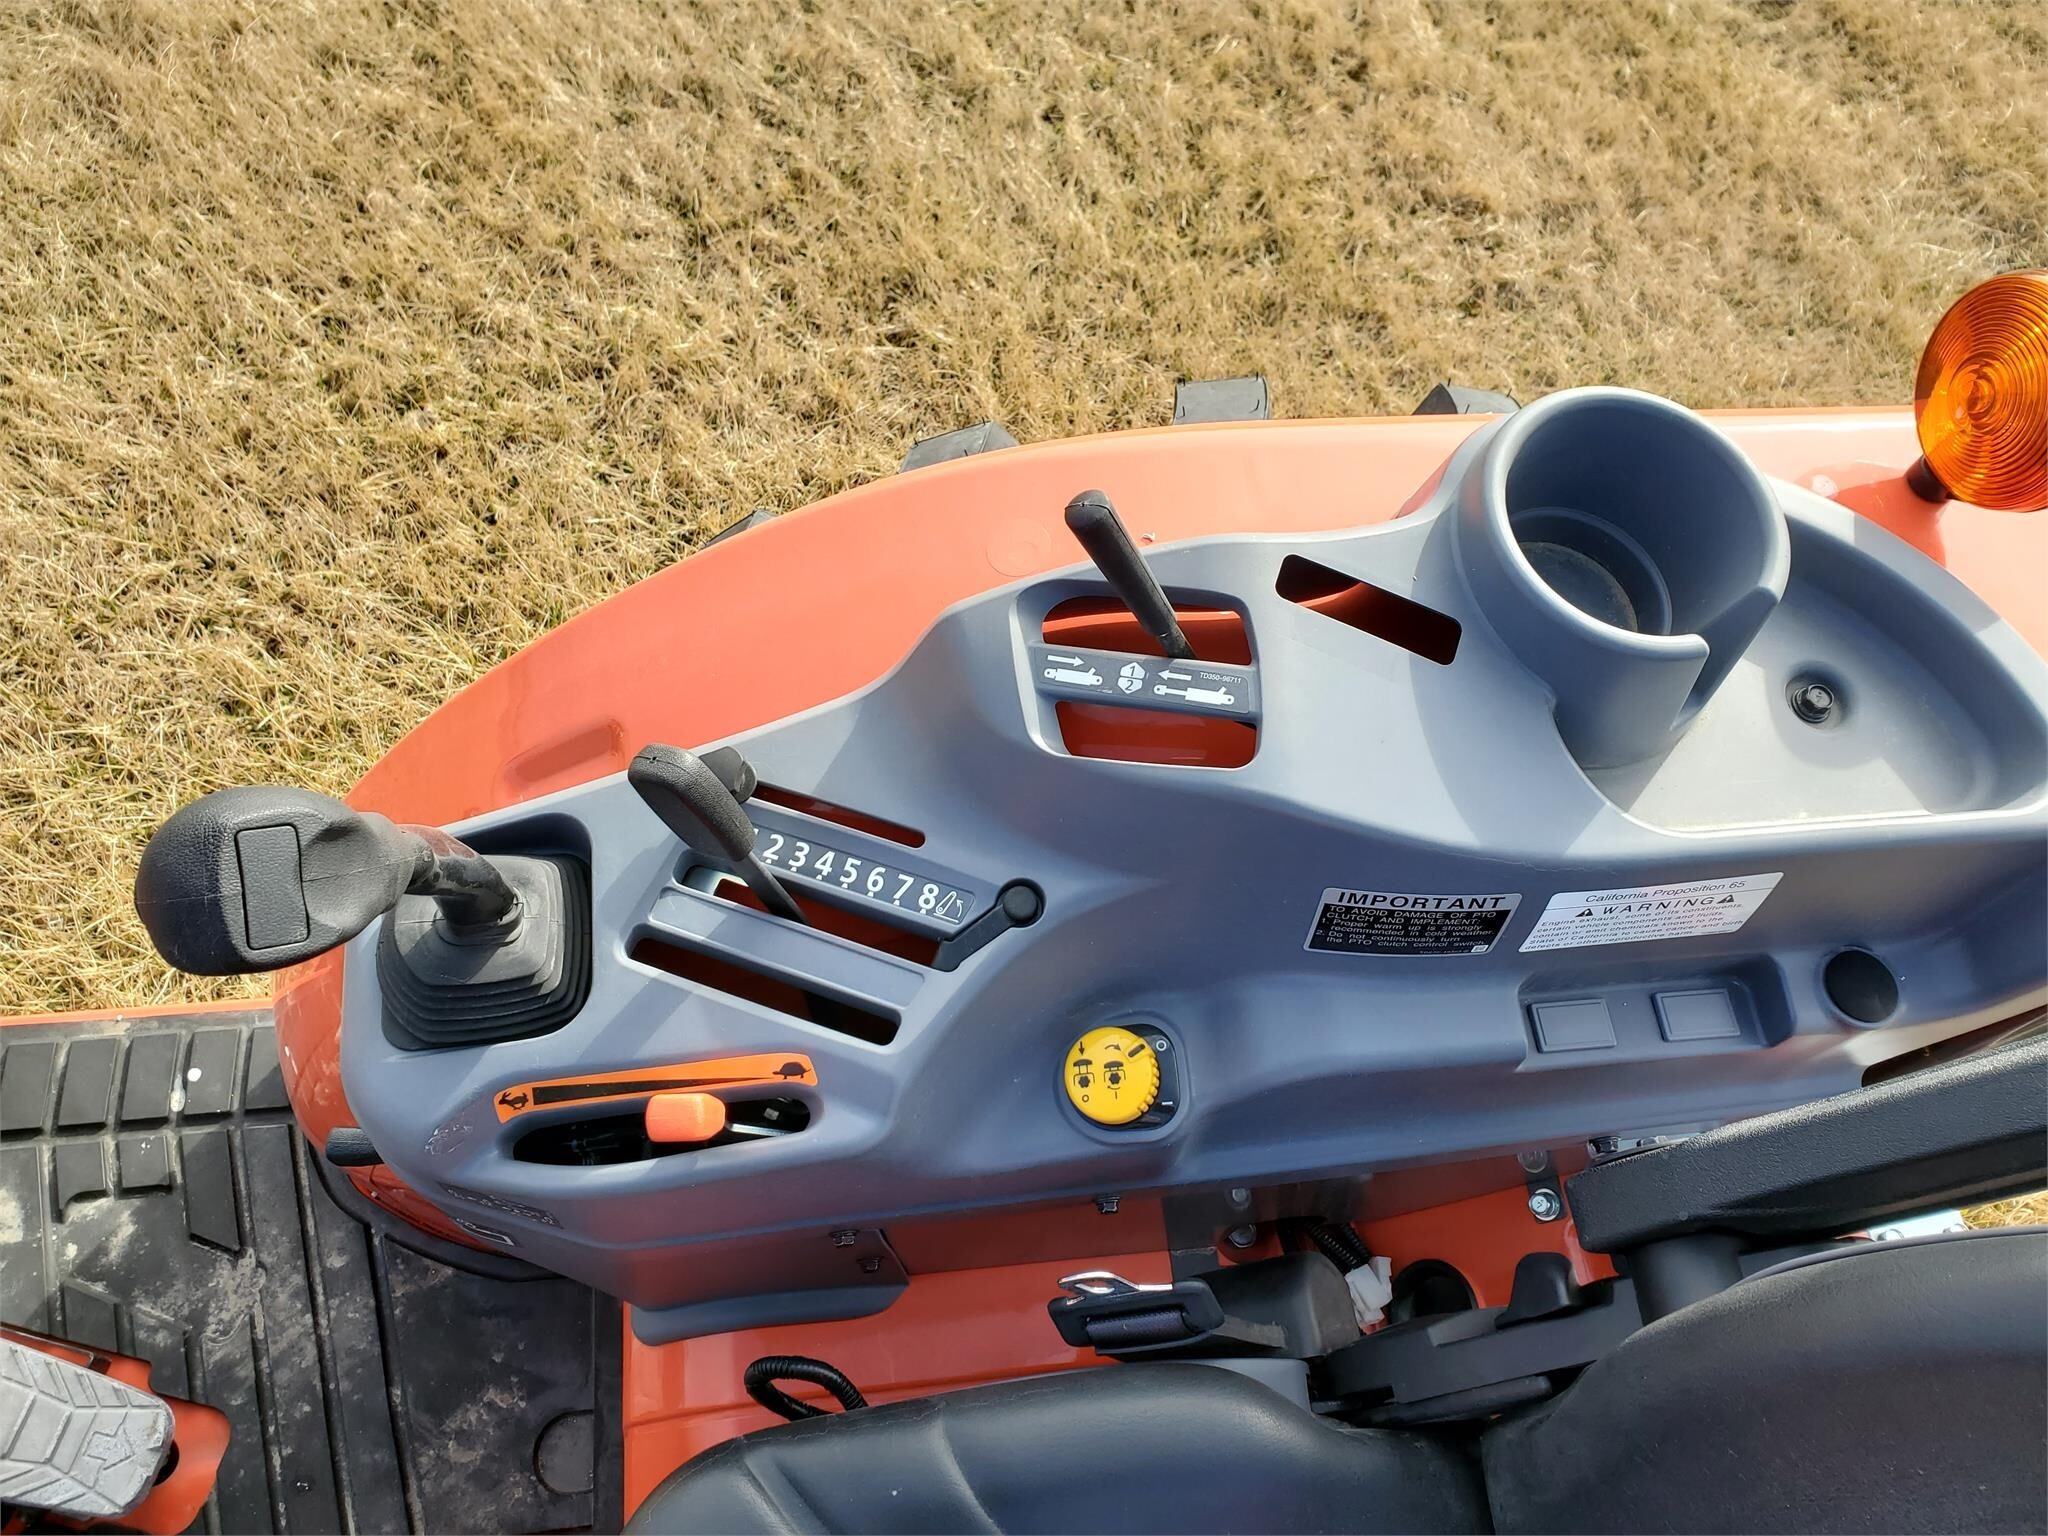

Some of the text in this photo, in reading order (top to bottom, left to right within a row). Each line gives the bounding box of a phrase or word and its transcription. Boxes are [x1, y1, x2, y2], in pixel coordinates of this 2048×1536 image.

[1129, 665, 1137, 677] 1
[1125, 679, 1134, 692] 2
[762, 834, 784, 860] 2
[788, 841, 810, 867] 3
[814, 850, 836, 876] 4
[840, 857, 862, 884] 5
[867, 866, 887, 892] 6
[893, 874, 915, 900] 7
[918, 883, 940, 910] 8
[1585, 881, 1745, 903] California Proposition 65
[1338, 892, 1506, 909] IMPORTANT
[1603, 897, 1715, 915] WARNING
[1327, 912, 1374, 922] CLUTCH
[1330, 905, 1346, 913] TO
[1351, 908, 1388, 917] AVOID
[1394, 911, 1445, 919] DAMAGE
[1333, 919, 1369, 928] Proper
[1441, 924, 1483, 932] strongly
[1536, 924, 1571, 933] certain
[1575, 921, 1610, 930] vehicle
[1612, 917, 1673, 927] components
[1541, 919, 1576, 927] Engine
[1328, 930, 1343, 938] Do
[1371, 934, 1436, 943] continuously
[1331, 925, 1404, 936] recommended
[1532, 930, 1569, 939] contain
[1570, 931, 1618, 941] California
